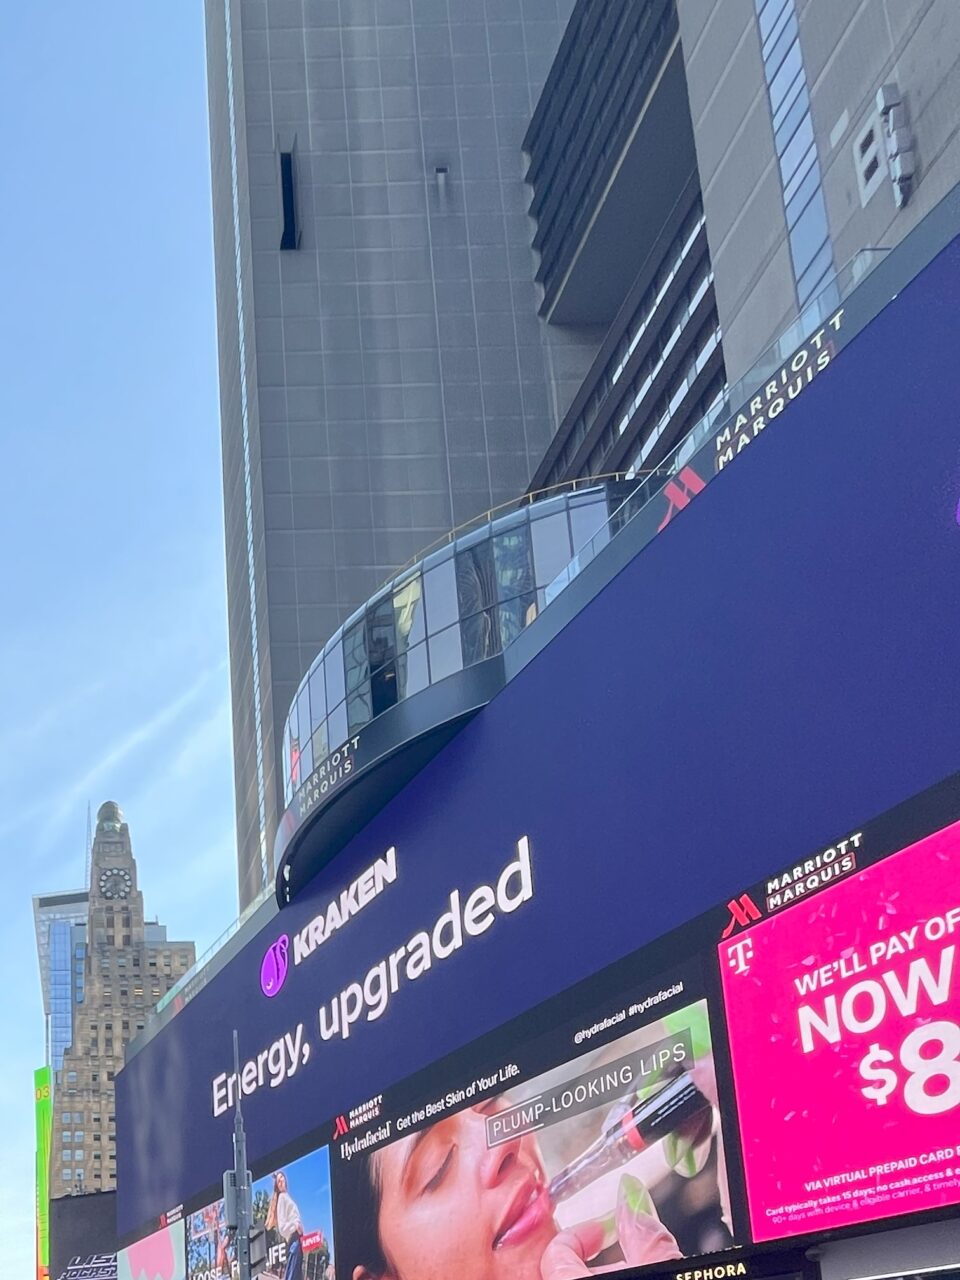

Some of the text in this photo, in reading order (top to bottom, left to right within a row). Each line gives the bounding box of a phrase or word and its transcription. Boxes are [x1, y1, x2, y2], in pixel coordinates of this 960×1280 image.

[716, 309, 844, 450] MARRIOTT
[718, 351, 830, 470] MARQUIS
[299, 736, 360, 803] MARRIOTT
[300, 760, 352, 817] MARQUIS
[767, 832, 863, 894] MARRIOTT
[768, 856, 855, 909] MARQUIS
[293, 846, 398, 966] KRAKEN
[212, 834, 534, 1118] Energy, upgraded
[870, 928, 919, 966] PAY
[574, 981, 684, 1044] @hydrafacial #hydrafacial
[797, 943, 954, 1054] NOW
[349, 1095, 383, 1120] MARRIOTT
[349, 1105, 380, 1129] MARQUIS
[396, 1063, 520, 1131] Get the Best Skin of Your Life.
[493, 1042, 687, 1137] PLUMP-LOOKING LIPS
[340, 1120, 391, 1161] Hydrafacial
[805, 1180, 823, 1192] VIA
[823, 1169, 868, 1188] VIRTUAL
[869, 1156, 918, 1178] PREPAID
[919, 1147, 955, 1165] CARD
[766, 1207, 784, 1217] Card
[784, 1199, 818, 1214] typically
[819, 1193, 841, 1205] takes
[842, 1191, 852, 1201] 15
[876, 1184, 888, 1193] no
[889, 1179, 911, 1190] cash
[911, 1171, 944, 1185] access
[944, 1168, 953, 1177] &
[772, 1216, 787, 1225] 90+
[788, 1211, 806, 1223] days
[824, 1202, 851, 1214] device
[892, 1186, 924, 1201] carrier,
[924, 1183, 932, 1192] &
[67, 1252, 118, 1270] LIS
